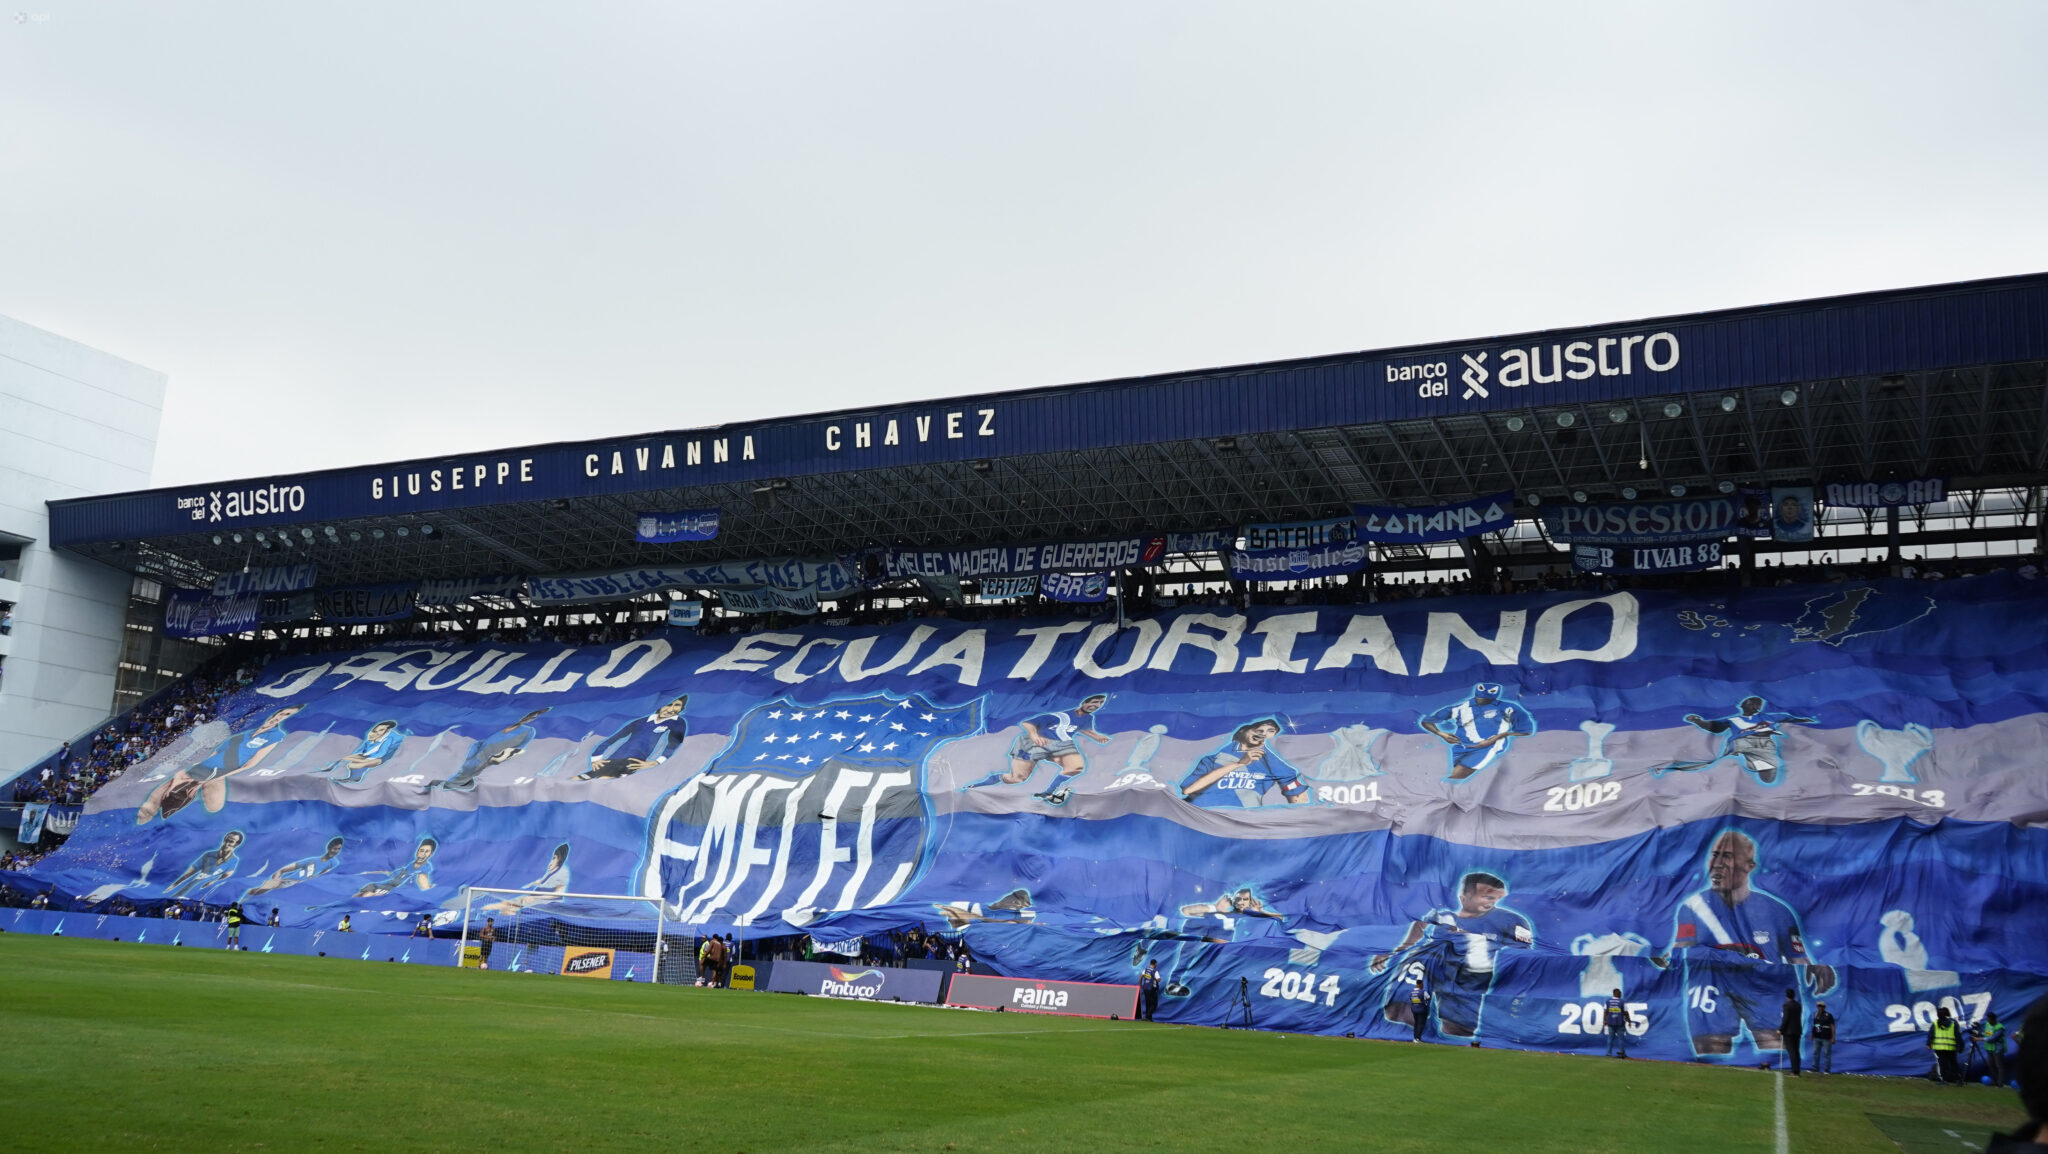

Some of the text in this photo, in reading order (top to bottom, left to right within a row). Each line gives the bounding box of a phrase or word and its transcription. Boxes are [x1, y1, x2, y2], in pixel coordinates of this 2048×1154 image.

[1387, 362, 1448, 383] banco
[1498, 332, 1680, 388] austro
[1419, 378, 1448, 398] del
[372, 409, 995, 500] GIUSEPPE CAVANNA CHAVEZ
[178, 496, 205, 509] banco
[225, 484, 305, 518] austro
[191, 508, 205, 520] del
[1366, 502, 1505, 537] COMANDO
[886, 539, 1139, 578] EMELEC MADERA DE GUERREROS
[1697, 543, 1721, 564] 88
[527, 558, 850, 600] REPUBLICA DEL EMELEC
[724, 591, 817, 610] GRAN COLOMBIA
[694, 592, 1639, 686] ECUATORIANO
[1217, 778, 1257, 790] CLUB
[1318, 781, 1381, 804] 2001
[1543, 781, 1622, 812] 2002
[1852, 783, 1945, 808] 2013
[570, 955, 606, 971] PILSENER
[820, 979, 875, 997] Pintuco
[1012, 985, 1069, 1007] Faina
[1260, 967, 1341, 1007] 2014
[1688, 984, 1720, 1014] 16
[1558, 1002, 1650, 1036] 205
